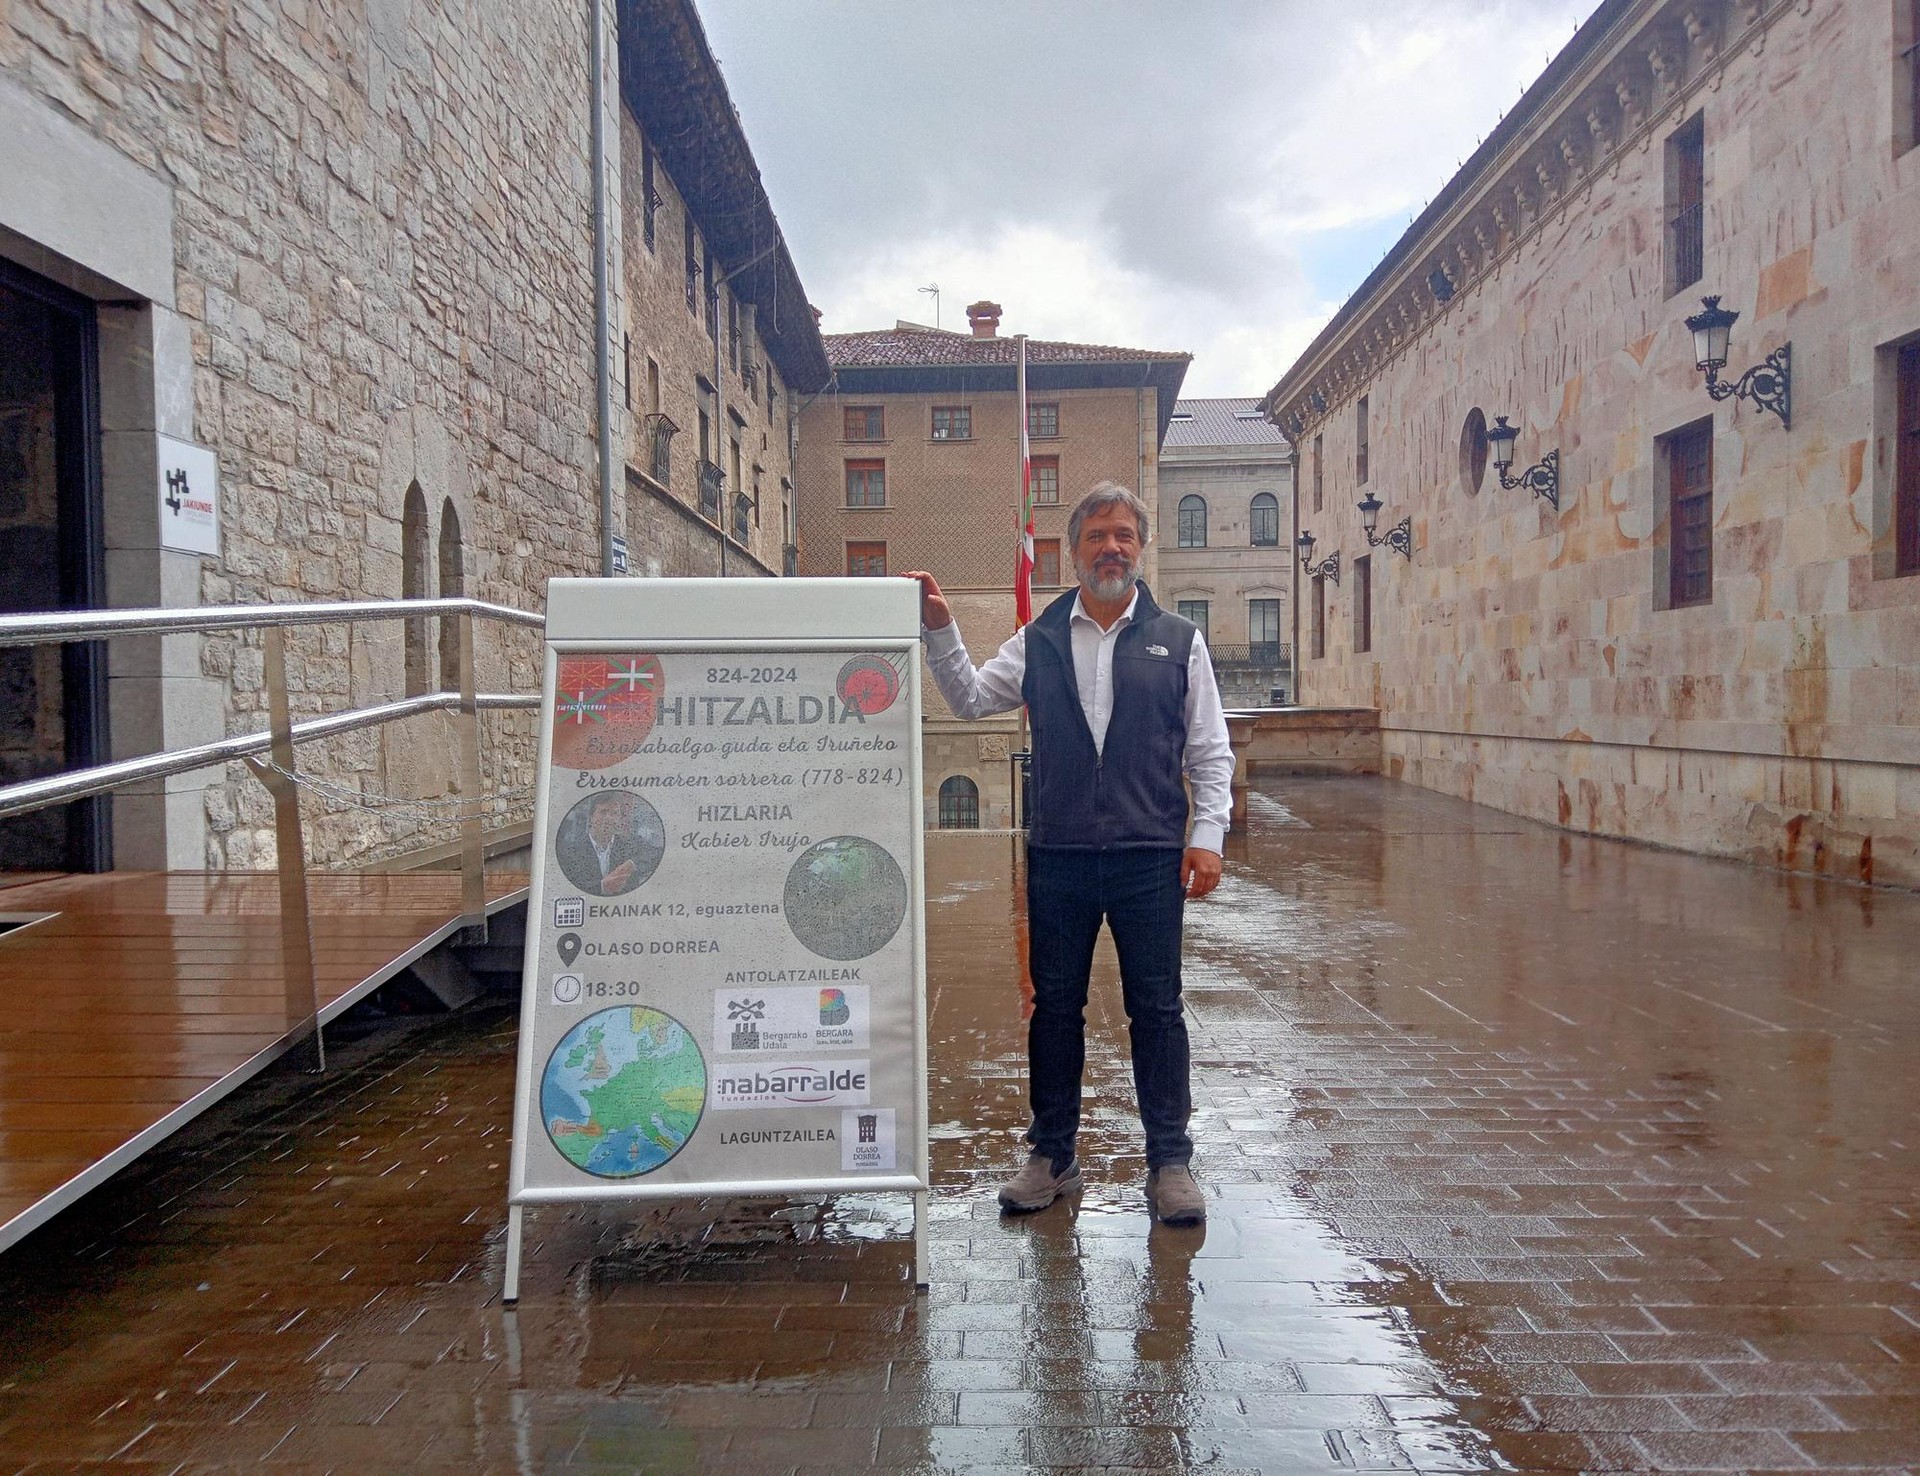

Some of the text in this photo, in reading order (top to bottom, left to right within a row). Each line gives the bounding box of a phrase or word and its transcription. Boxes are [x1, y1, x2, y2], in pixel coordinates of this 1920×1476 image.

[183, 499, 213, 513] JAKIUNDE
[707, 668, 797, 683] 824-2024
[656, 695, 866, 726] HITZALDIA
[722, 740, 773, 759] guda
[778, 736, 810, 752] eta
[817, 734, 898, 752] Iruñeko
[576, 768, 903, 788] Erresumaren sorrera (778-824)
[698, 804, 793, 822] HIZLARIA
[759, 830, 812, 852] Irujo
[589, 902, 779, 919] EKAINAK 12, eguaztena
[585, 940, 720, 956] OLASO DORREA
[725, 968, 861, 983] ANTOLATZAILEAK
[586, 981, 640, 996] 18:30
[763, 1031, 808, 1041] Bergarako
[816, 1029, 854, 1038] BERGARA
[721, 1070, 866, 1094] nabarralde
[720, 1129, 836, 1145] LAGUNTZAILEA
